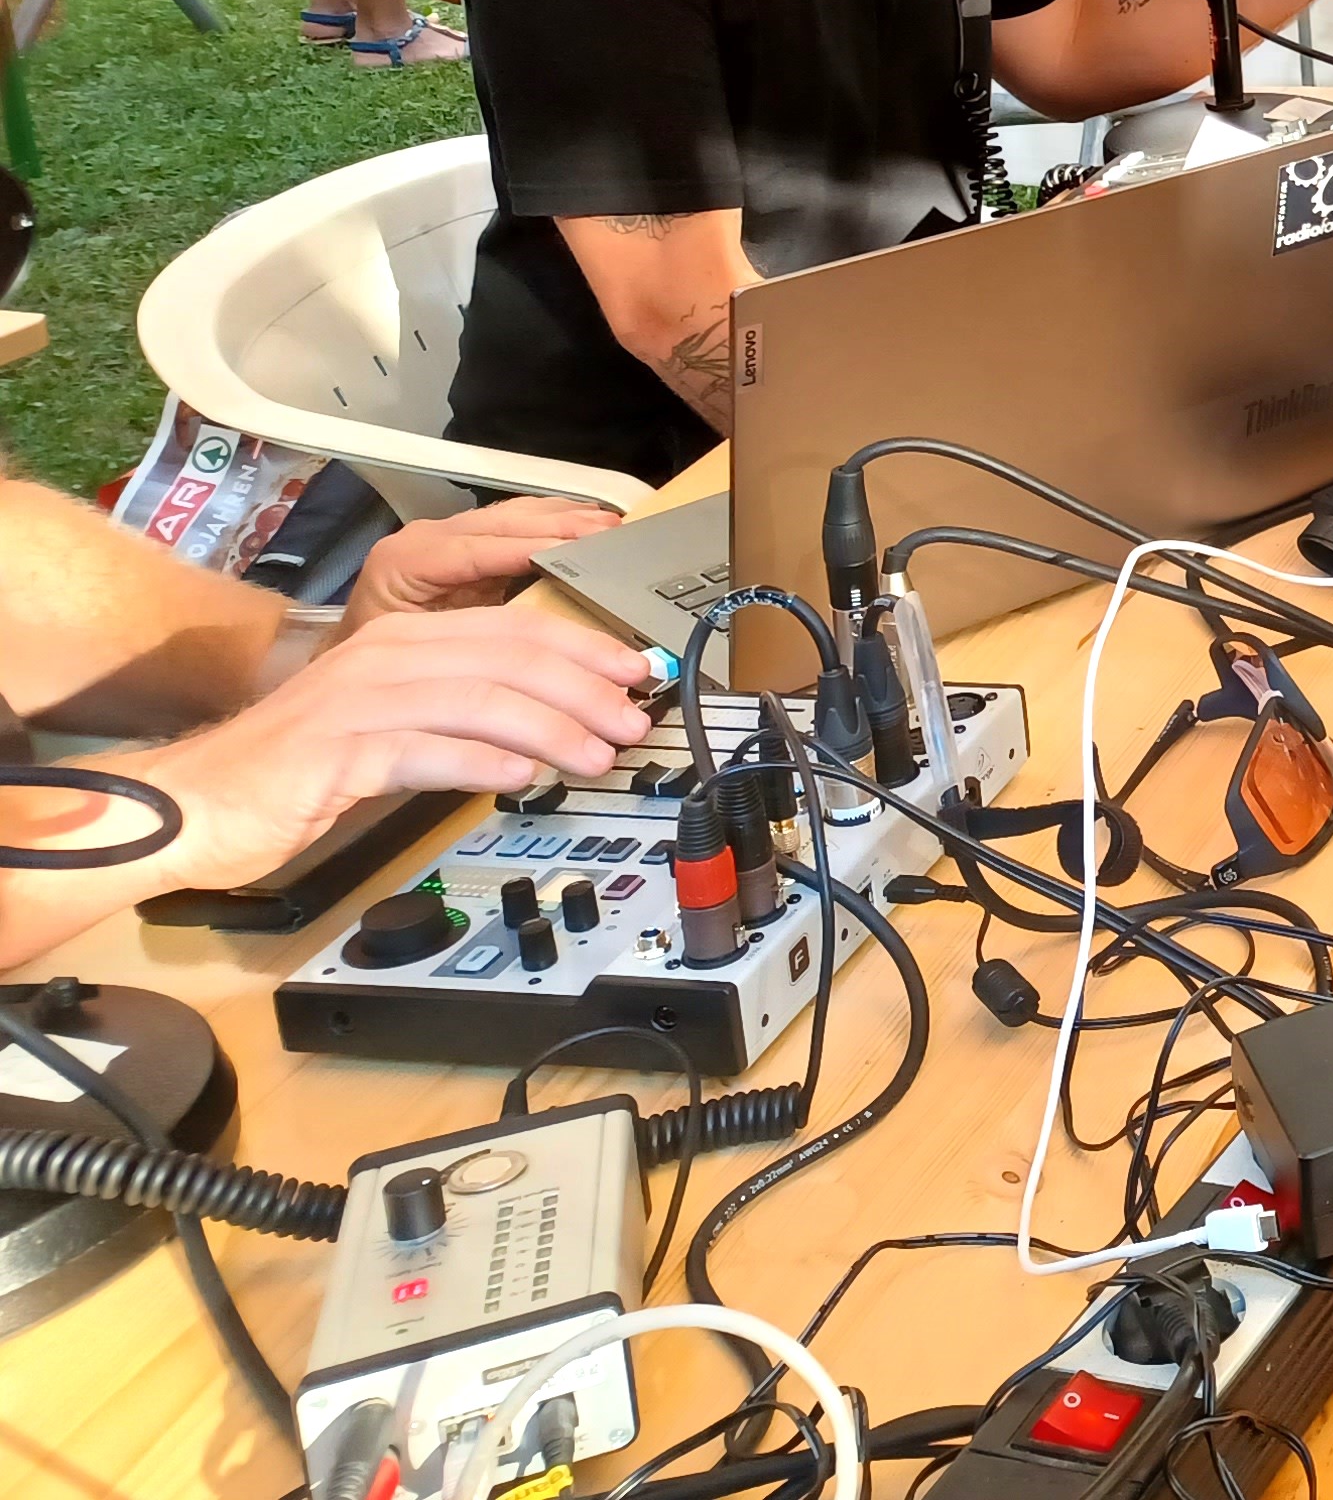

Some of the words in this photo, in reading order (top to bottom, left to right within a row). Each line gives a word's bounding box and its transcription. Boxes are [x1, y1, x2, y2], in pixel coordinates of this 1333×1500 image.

[742, 329, 756, 387] Lenovo
[155, 482, 210, 541] AR
[550, 559, 581, 579] Lenovo
[793, 946, 806, 972] F
[798, 1138, 830, 1162] AWG24
